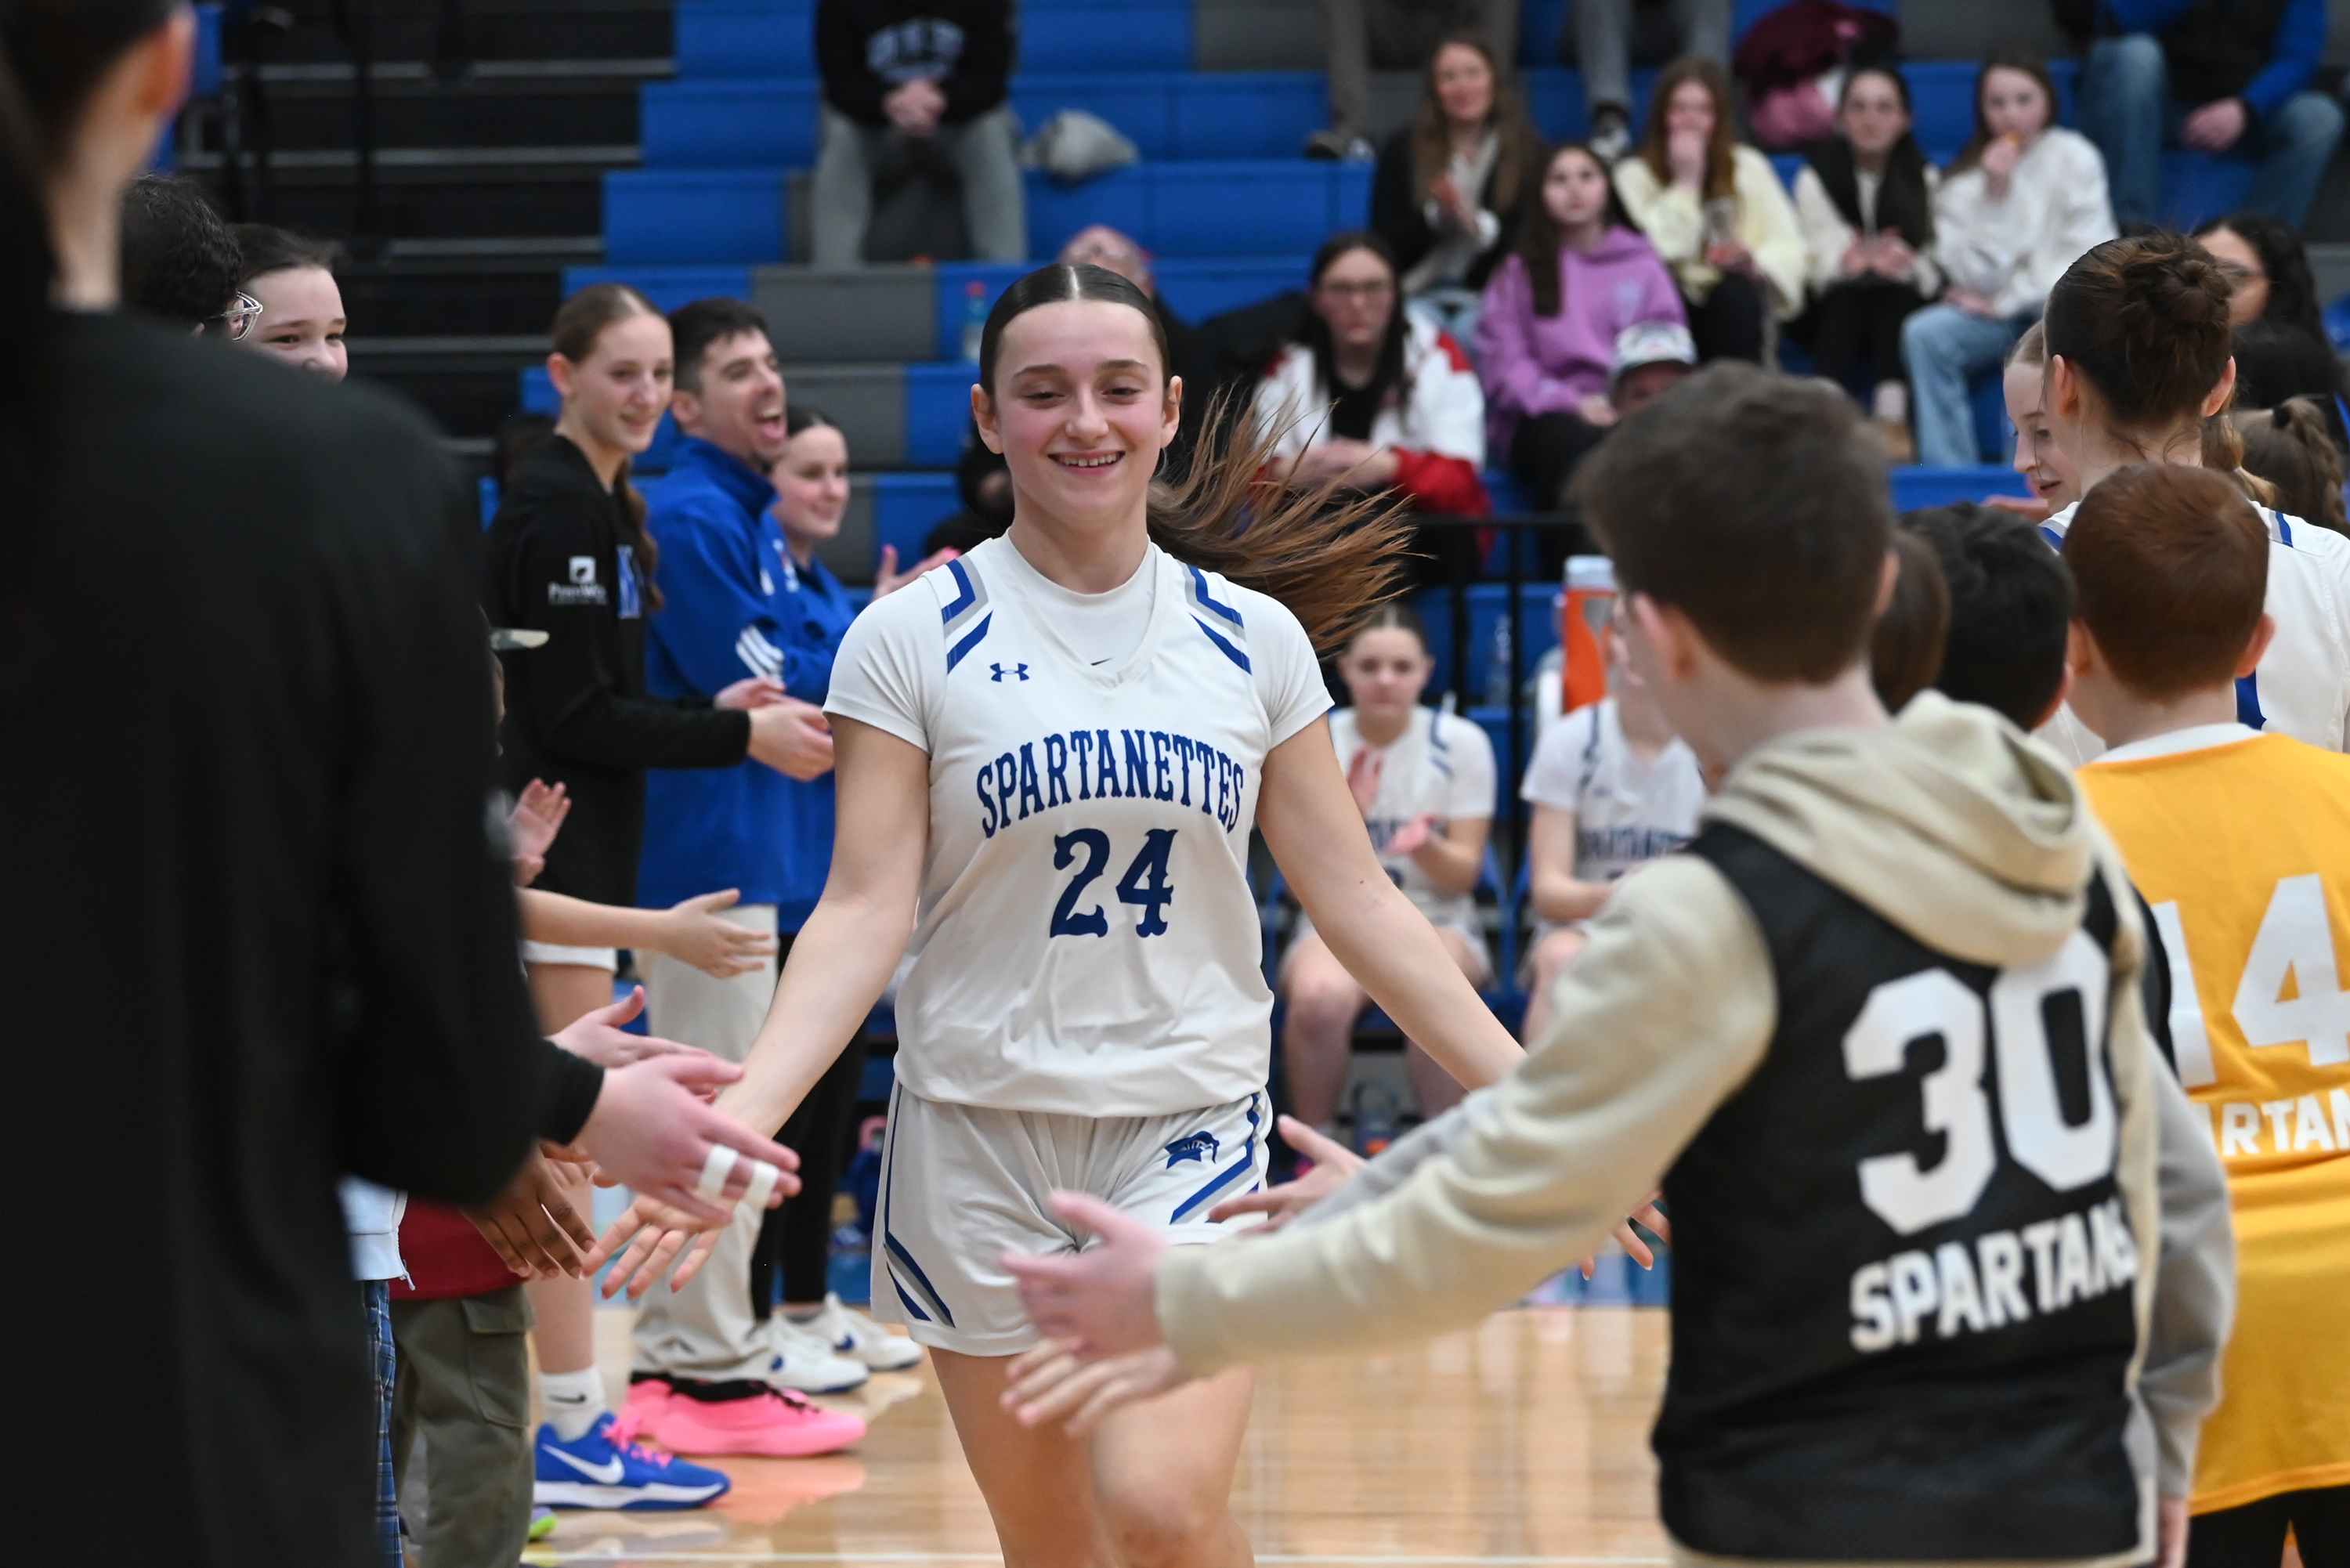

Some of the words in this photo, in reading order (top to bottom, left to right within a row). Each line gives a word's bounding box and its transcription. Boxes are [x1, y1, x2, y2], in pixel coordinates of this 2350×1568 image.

[977, 729, 1243, 839] SPARTANETTES
[1050, 828, 1178, 938] 24
[1841, 927, 2117, 1236] 30
